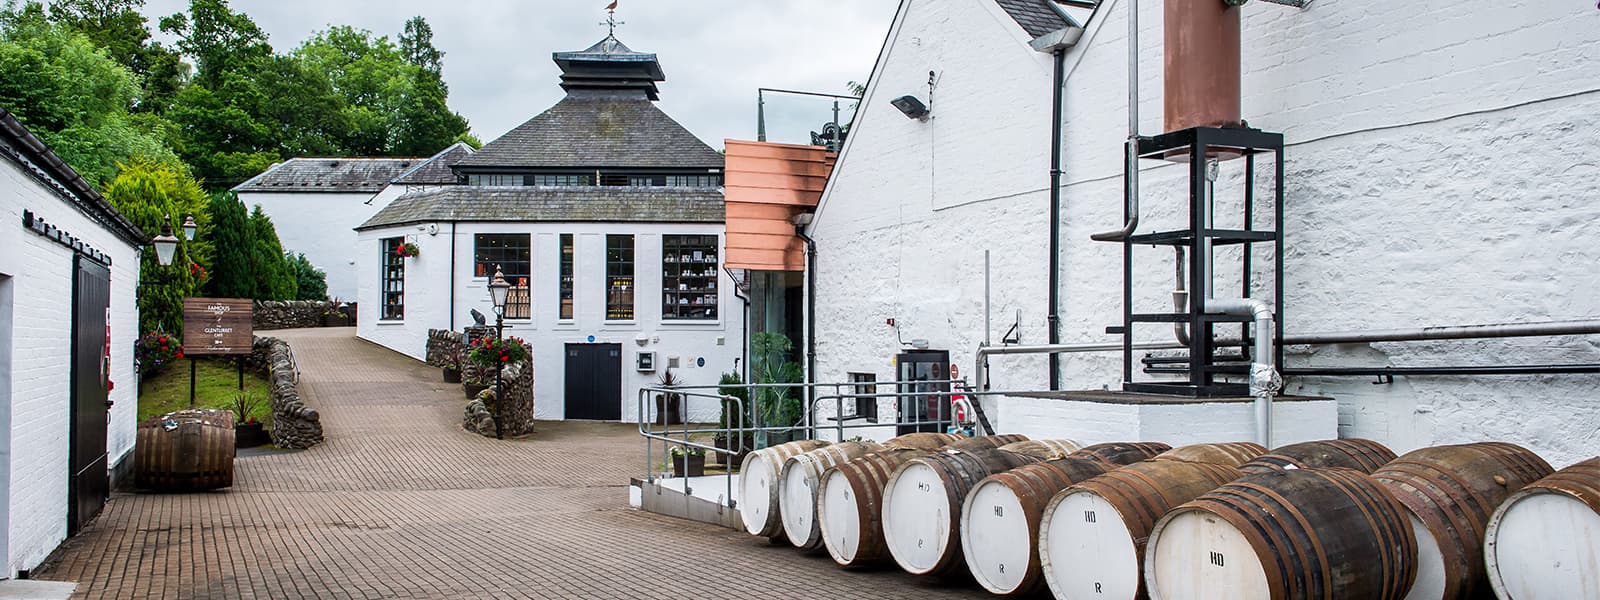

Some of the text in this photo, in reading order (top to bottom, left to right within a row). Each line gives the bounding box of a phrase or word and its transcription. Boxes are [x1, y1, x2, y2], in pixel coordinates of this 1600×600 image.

[1210, 551, 1224, 567] HD
[999, 563, 1005, 574] R
[1094, 582, 1102, 594] R
